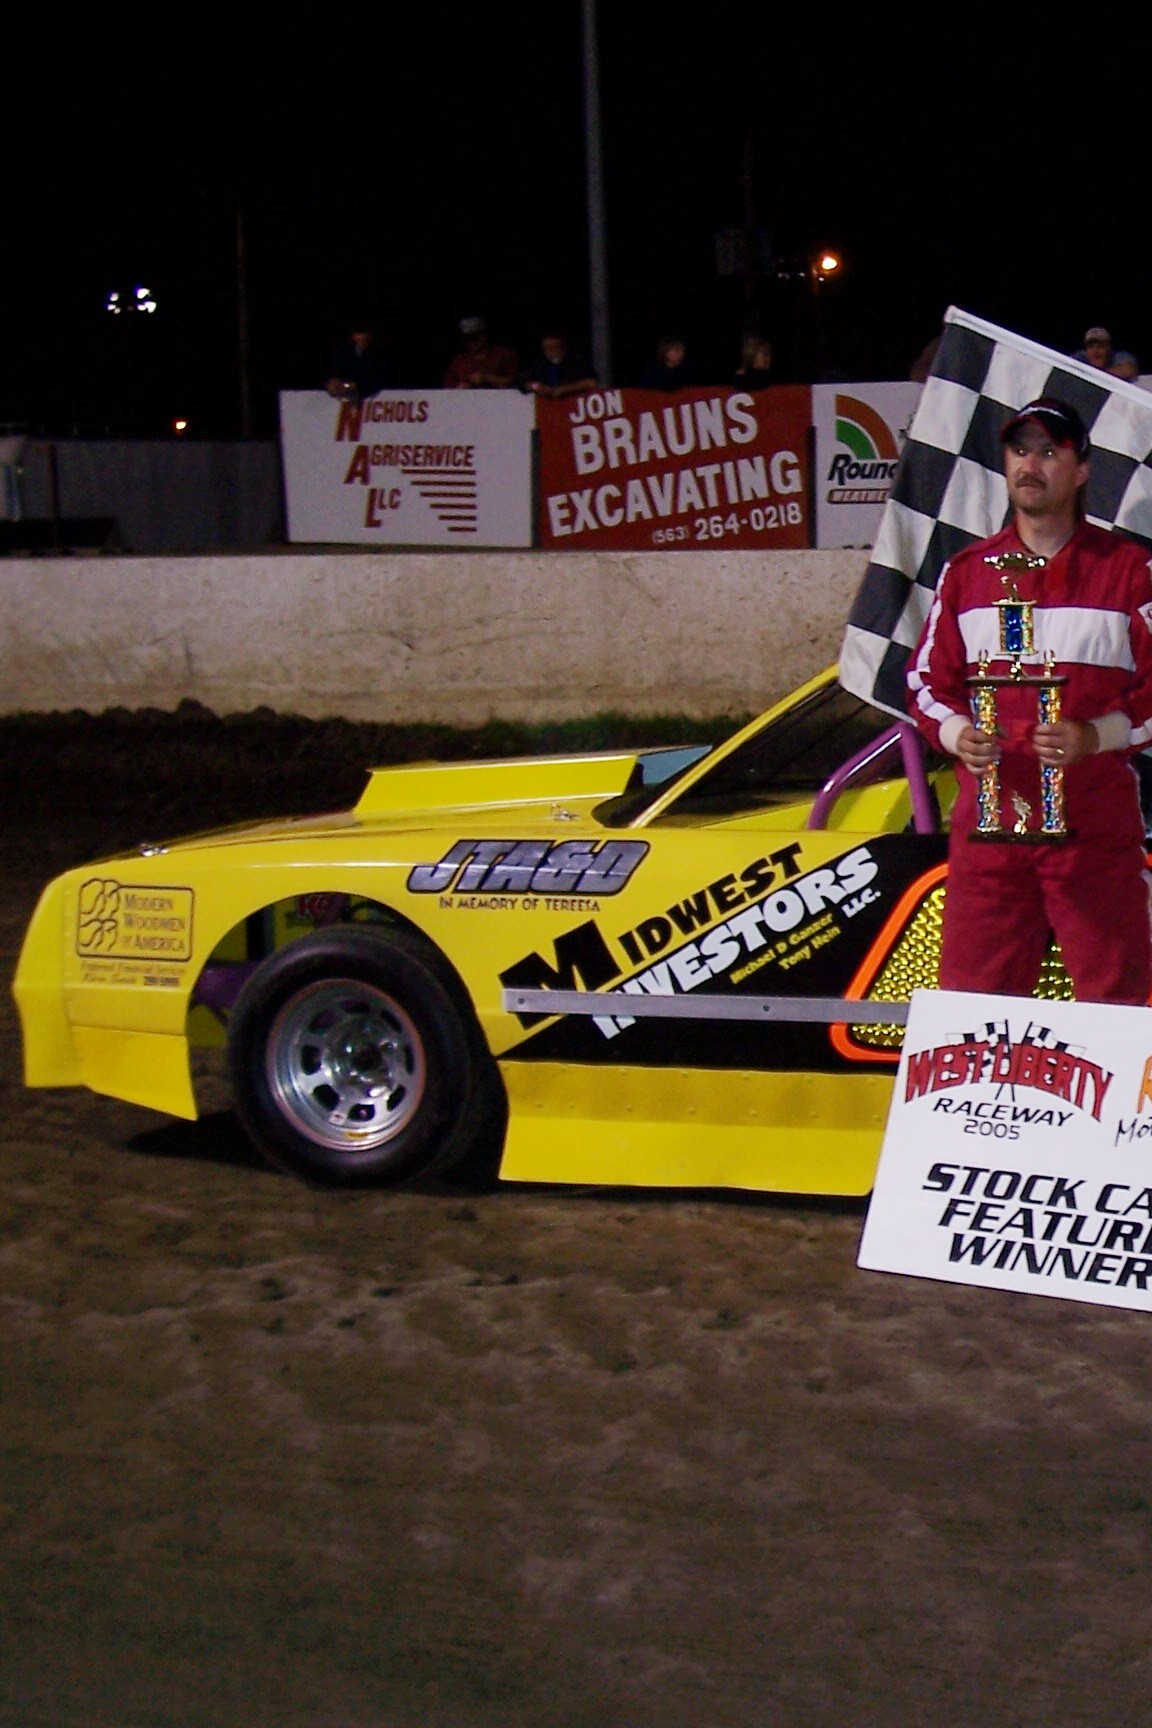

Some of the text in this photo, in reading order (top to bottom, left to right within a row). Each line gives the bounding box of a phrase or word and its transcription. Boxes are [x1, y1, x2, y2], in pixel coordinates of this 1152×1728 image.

[335, 400, 430, 442] NICHOLS
[569, 389, 624, 424] JON
[571, 392, 759, 476] BRAUNS
[344, 445, 475, 486] AGRISERVICE
[364, 488, 401, 528] LLC
[547, 450, 803, 538] EXCAVATING
[694, 501, 803, 542] 264-0218
[439, 896, 453, 909] IN
[458, 897, 518, 910] MEMORY
[522, 898, 540, 911] OF
[840, 890, 882, 919] LLC.
[497, 843, 804, 1030] MIDWEST
[905, 1036, 1115, 1122] WEST LIBERTY
[934, 1096, 1075, 1128] RACEWAY
[963, 1117, 1021, 1140] 2005
[922, 1162, 1086, 1210] STOCK
